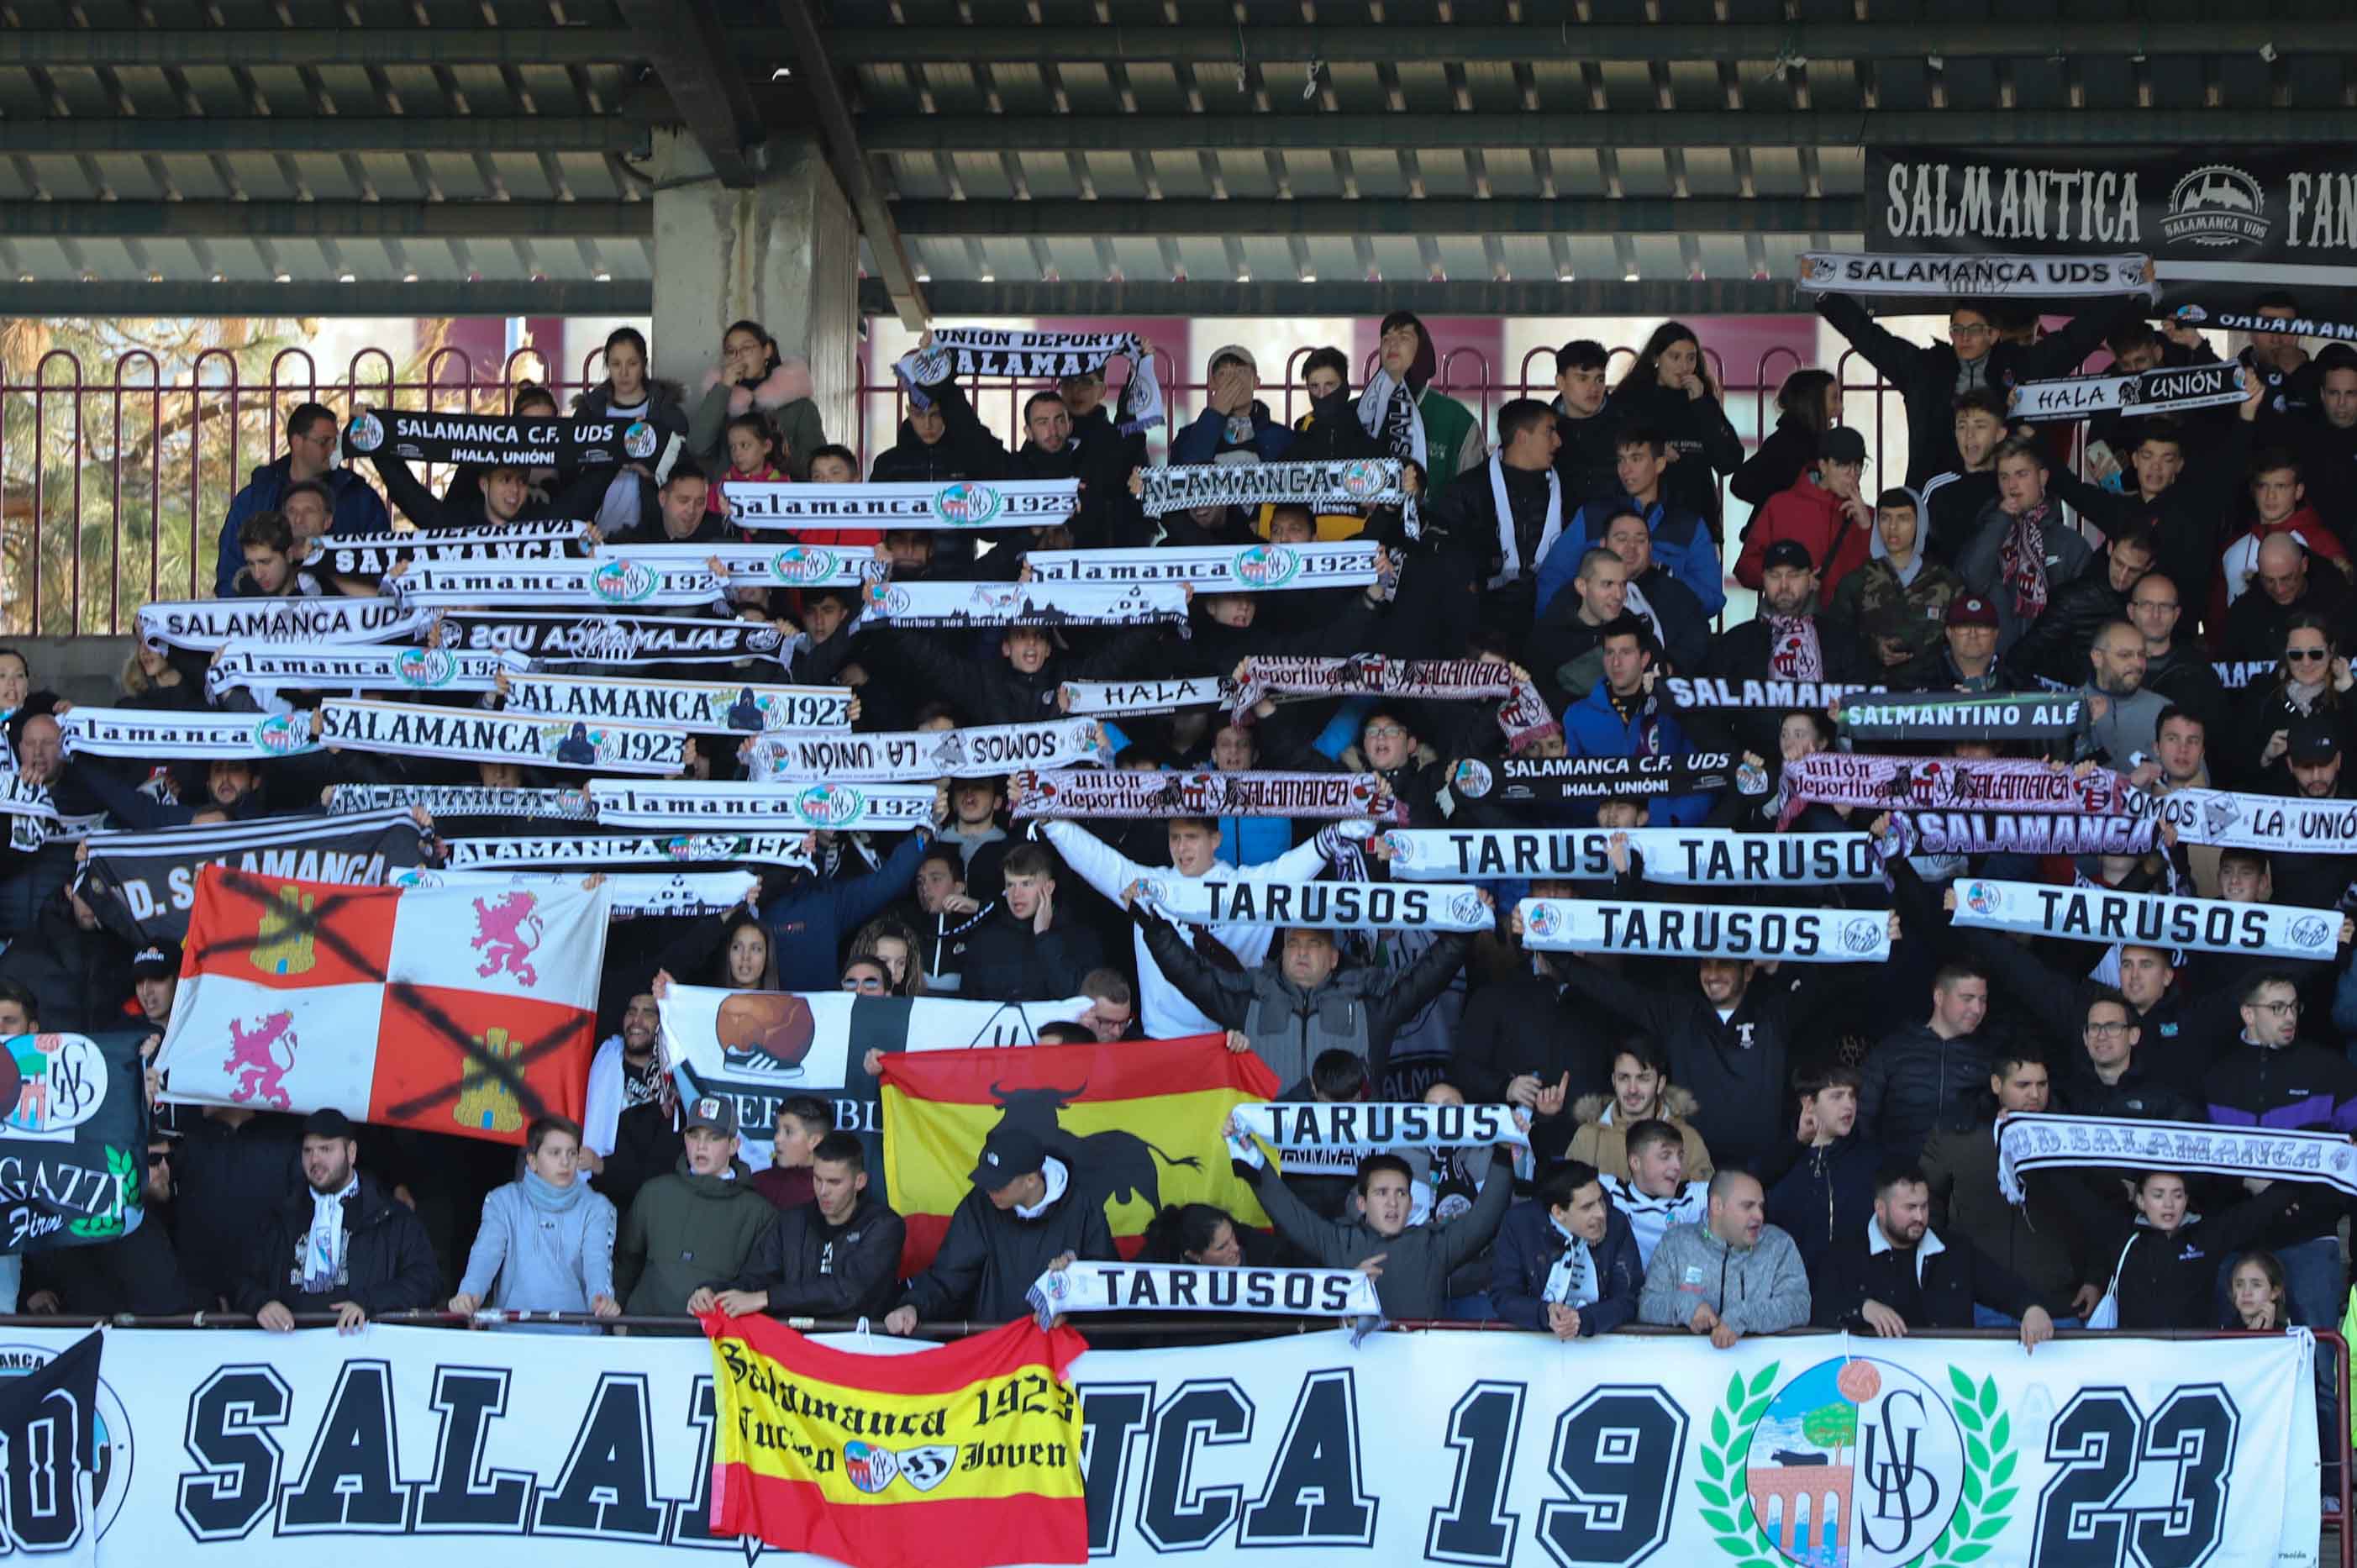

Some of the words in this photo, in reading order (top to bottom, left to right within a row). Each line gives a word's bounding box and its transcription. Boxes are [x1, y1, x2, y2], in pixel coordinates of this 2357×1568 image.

[1886, 162, 2142, 244] SALMANTICA
[2165, 216, 2239, 237] SALAMANCA
[2244, 224, 2268, 239] UDS
[1846, 260, 2037, 284] SALAMANCA
[2047, 262, 2109, 284] UDS
[956, 349, 1108, 376] ALAMAN
[2038, 387, 2105, 410] HALA
[2149, 370, 2223, 398] UNIÓN
[397, 418, 518, 444] SALAMANCA
[528, 426, 560, 444] C.F.
[573, 423, 614, 443] UDS
[502, 450, 555, 466] UNIÓN!
[1142, 465, 1334, 504] ALAMANCA
[1004, 495, 1078, 513] 1923
[1302, 555, 1376, 573] 1923
[393, 570, 587, 598] alamanca
[662, 573, 716, 590] 192
[168, 609, 350, 637] SALAMANCA
[459, 660, 506, 676] 192
[507, 682, 713, 722] SALAMANCA
[787, 696, 851, 728] 1923
[1105, 680, 1199, 705] HALA
[1667, 676, 1888, 708] SALAMAN
[1849, 706, 2021, 726] SALMANTINO
[2031, 699, 2081, 725] ALÉ
[65, 717, 249, 745] alamanca
[322, 707, 542, 755] SALAMANCA
[618, 731, 686, 765] 1923
[971, 730, 1056, 764] SOMOS
[1503, 757, 1630, 778] SALAMANCA
[1639, 755, 1673, 773] C.F.
[1687, 752, 1731, 770] UDS
[1615, 777, 1669, 795] UNIÓN!
[866, 799, 933, 816] 192
[2253, 809, 2285, 837] LA
[2299, 805, 2357, 839] UNIÓ
[1918, 813, 2154, 855] SALAMANCA
[447, 838, 660, 866] ALAMANCA
[1449, 834, 1610, 875] TARUS
[1679, 839, 1876, 881] TARUSO
[168, 849, 387, 910] SAMANCA
[1203, 881, 1428, 924] TARUSOS
[2038, 890, 2270, 949] TARUSOS
[1597, 908, 1822, 956] TARUSOS
[1265, 1105, 1500, 1144] TARUSOS
[0, 1156, 124, 1218] GAZZI
[1097, 1269, 1351, 1312] TARUSOS
[718, 1343, 948, 1438] Salamanca
[973, 1373, 1076, 1428] 1923
[176, 1356, 1380, 1566] SALACA
[961, 1439, 1067, 1473] Joven
